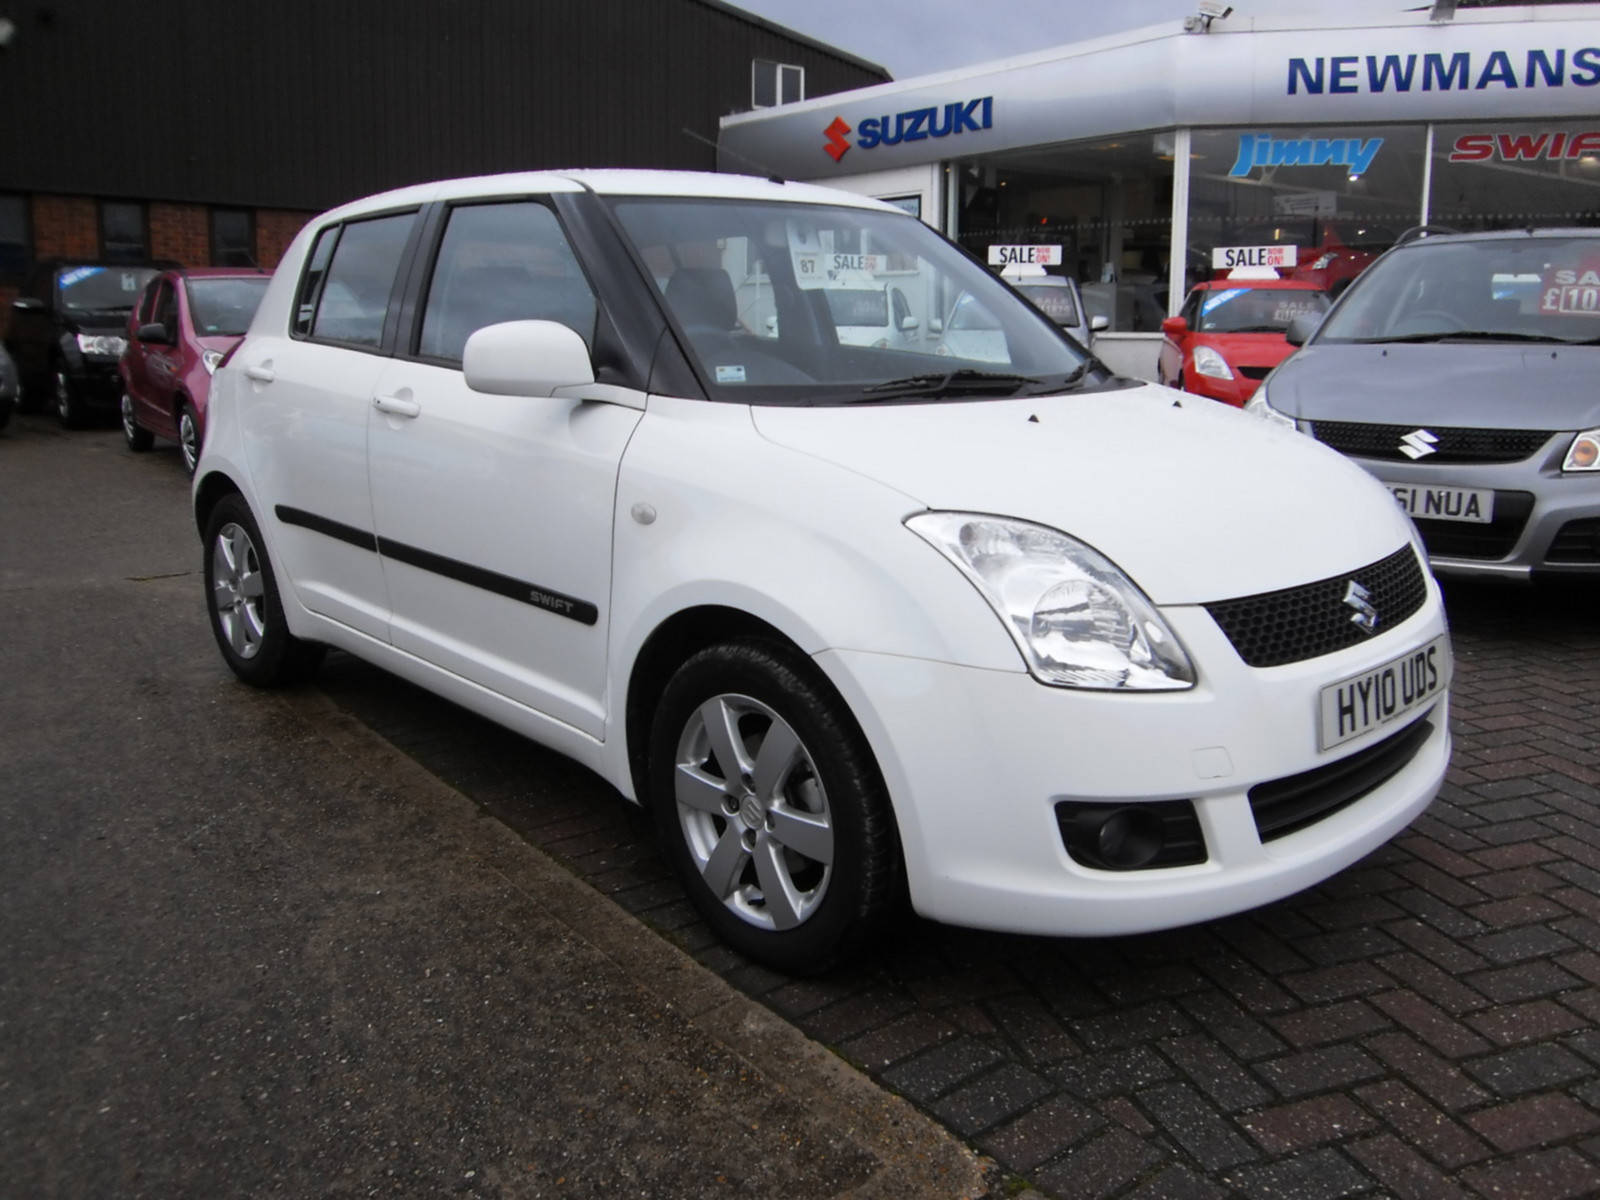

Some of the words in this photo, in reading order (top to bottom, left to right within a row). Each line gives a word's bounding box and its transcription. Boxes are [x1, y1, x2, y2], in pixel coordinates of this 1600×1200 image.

[1287, 48, 1600, 95] NEWMANS
[858, 96, 993, 149] SUZUKI
[1229, 133, 1384, 177] Jimny
[834, 255, 864, 270] SALE
[999, 247, 1035, 263] SALE
[1225, 248, 1267, 266] SALE
[1555, 270, 1600, 286] SA
[1425, 490, 1480, 518] NUA
[530, 590, 574, 613] SWIFT
[1402, 646, 1437, 706] UDS
